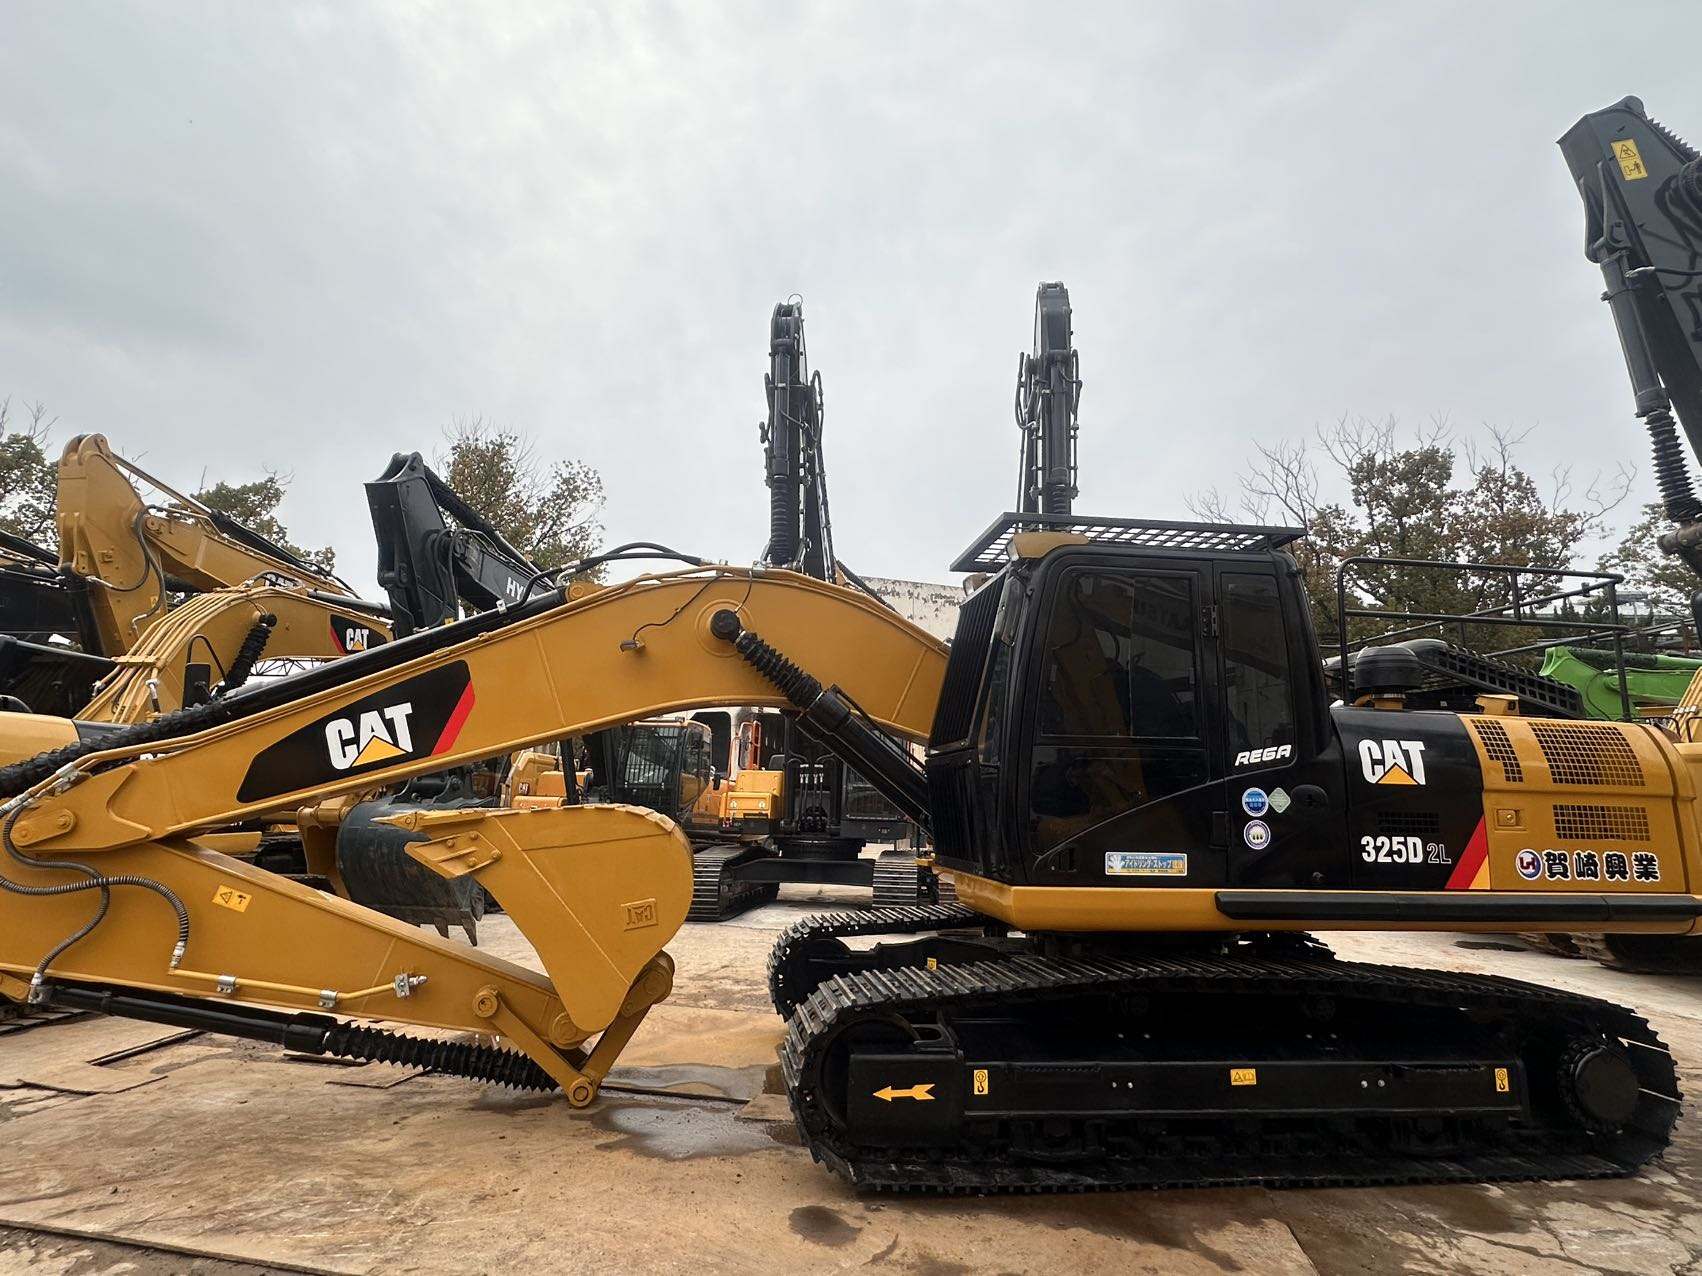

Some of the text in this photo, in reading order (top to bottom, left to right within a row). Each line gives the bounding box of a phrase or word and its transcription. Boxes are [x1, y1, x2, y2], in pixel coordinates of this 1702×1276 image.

[345, 628, 369, 651] CAT
[325, 702, 413, 770] CAT
[1234, 744, 1292, 766] REGA
[1358, 739, 1426, 785] CAT
[1360, 835, 1452, 864] 325D 2L
